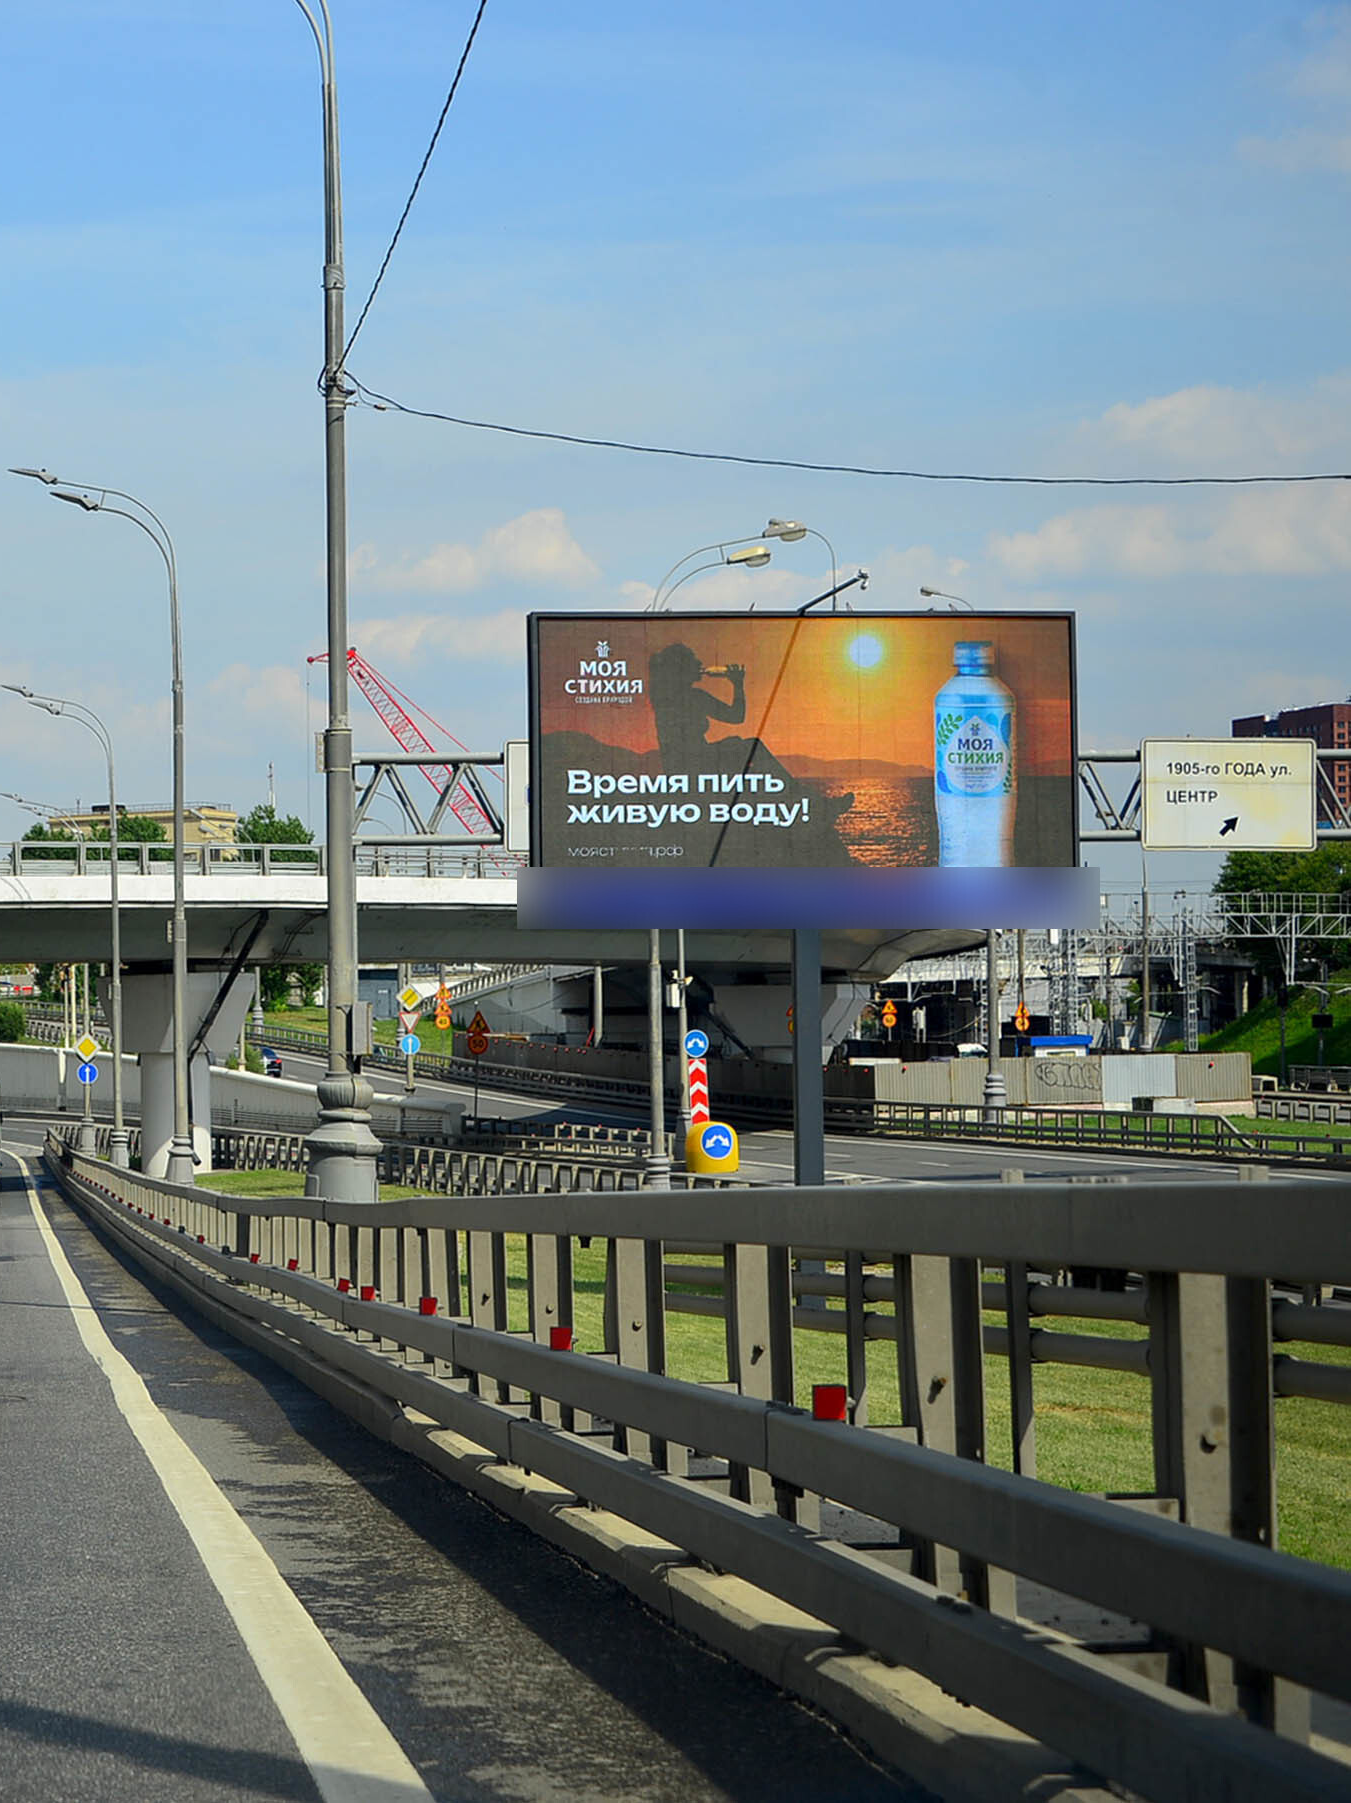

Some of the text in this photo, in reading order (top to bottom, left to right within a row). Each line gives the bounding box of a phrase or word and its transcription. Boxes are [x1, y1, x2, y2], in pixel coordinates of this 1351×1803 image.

[579, 660, 627, 677] МОЯ
[564, 679, 643, 694] СТИХИЯ
[957, 738, 993, 751] МОЯ
[947, 752, 1004, 764] СТИХИЯ
[1166, 762, 1293, 778] 1905-го ГОДА ул.
[566, 769, 785, 799] Время пить
[1166, 789, 1219, 805] ЦЕНТР
[566, 798, 811, 828] живую воду!
